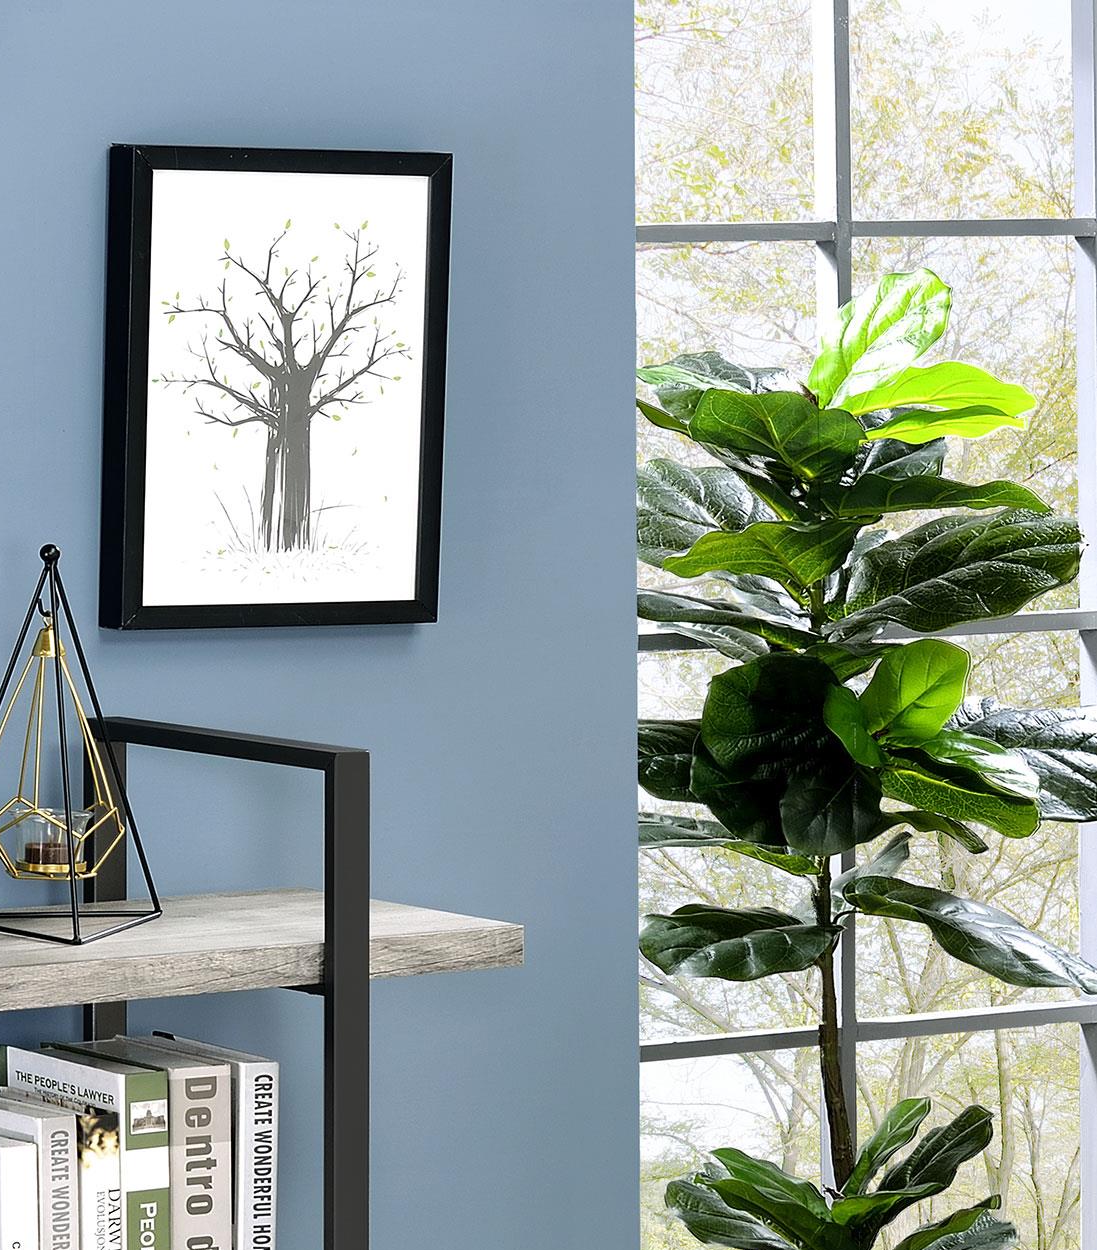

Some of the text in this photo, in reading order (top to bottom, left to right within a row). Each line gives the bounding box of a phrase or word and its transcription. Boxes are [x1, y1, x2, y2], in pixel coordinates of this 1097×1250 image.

[15, 1070, 115, 1105] THE PEOPLE'S LAWYER
[254, 1074, 273, 1125] CREATE
[50, 1130, 70, 1181] CREATE
[184, 1075, 217, 1216] Dentro
[253, 1129, 272, 1220] WONDERFUL
